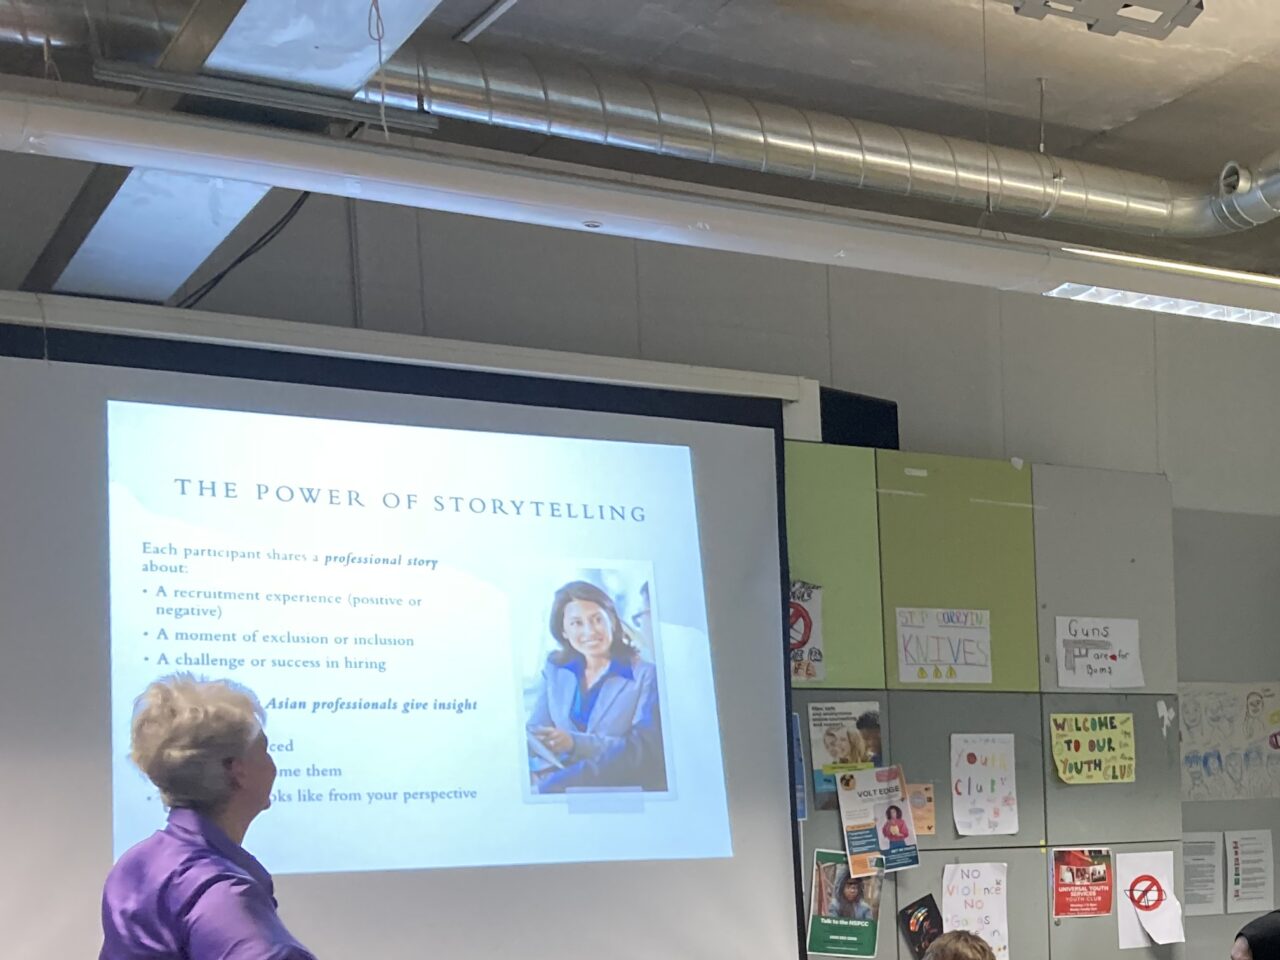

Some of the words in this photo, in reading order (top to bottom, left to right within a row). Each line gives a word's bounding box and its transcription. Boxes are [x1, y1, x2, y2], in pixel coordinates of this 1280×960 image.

[174, 478, 239, 498] THE
[256, 484, 365, 507] POWER
[382, 493, 418, 510] OF
[433, 495, 646, 522] STORYTELLING
[142, 541, 178, 556] Each
[184, 547, 261, 562] participant
[267, 549, 307, 562] shares
[312, 554, 319, 562] a
[324, 552, 402, 567] professional
[407, 556, 439, 571] story
[142, 559, 189, 574] about:
[156, 585, 168, 597] A
[174, 588, 260, 601] recruitment
[266, 592, 342, 606] experience
[347, 593, 403, 608] (positive
[408, 597, 422, 607] or
[156, 604, 222, 620] negative)
[1068, 618, 1109, 638] Guns
[156, 628, 169, 640] A
[175, 631, 237, 642] moment
[242, 629, 260, 643] of
[262, 631, 328, 645] exclusion
[334, 636, 349, 645] or
[354, 633, 414, 647] inclusion
[902, 633, 988, 665] KNIVES
[157, 652, 169, 665] A
[175, 652, 245, 670] challenge
[250, 658, 266, 667] or
[272, 658, 321, 668] success
[326, 656, 339, 668] in
[344, 656, 387, 673] hiring
[265, 697, 307, 710] Asian
[312, 697, 398, 714] professionals
[401, 698, 428, 714] give
[433, 698, 478, 714] insight
[1052, 715, 1117, 732] WELCOME
[1064, 738, 1081, 752] TO
[1088, 737, 1116, 752] OUR
[306, 763, 342, 777] them
[1060, 757, 1102, 775] YOUTH
[297, 788, 323, 802] like
[329, 788, 362, 802] from
[366, 792, 398, 804] your
[403, 787, 478, 804] perspective
[960, 868, 981, 880] NO
[964, 899, 985, 911] NO
